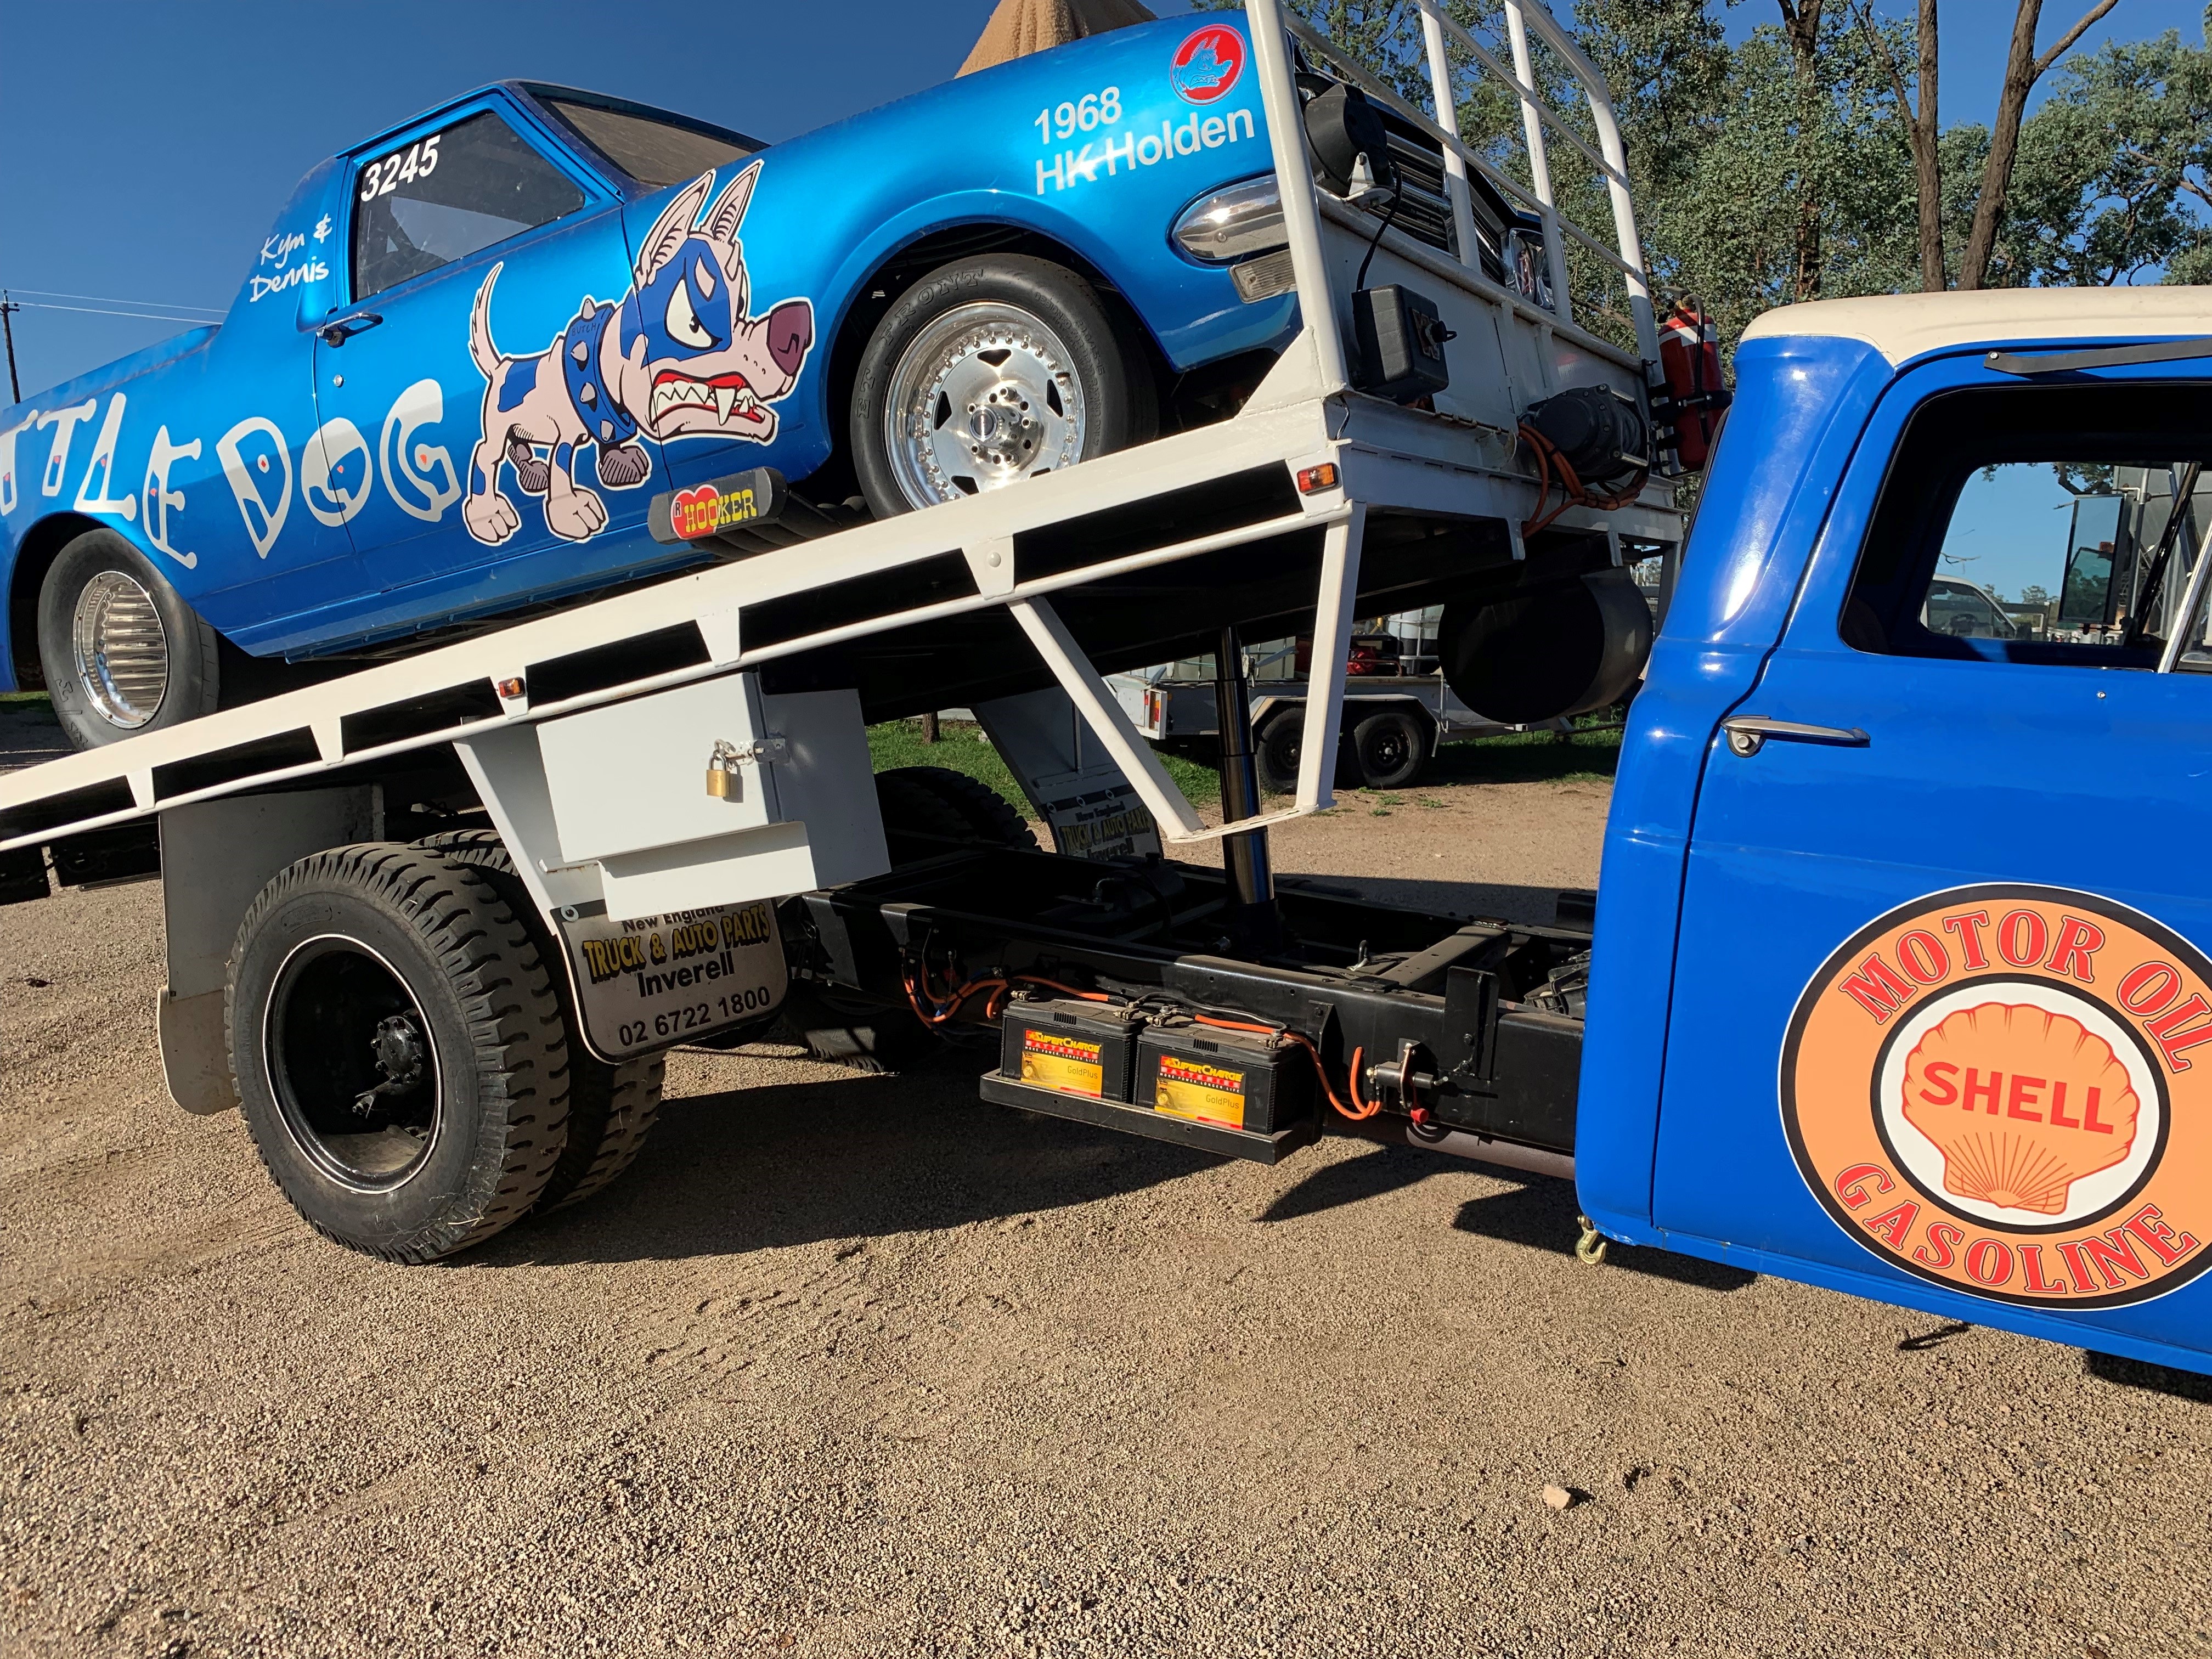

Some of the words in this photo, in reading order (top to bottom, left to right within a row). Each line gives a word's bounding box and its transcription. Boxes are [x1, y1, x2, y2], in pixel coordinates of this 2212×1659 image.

[1035, 86, 1122, 144] 1968
[361, 135, 441, 201] 3245
[1036, 143, 1098, 195] HK
[1106, 108, 1255, 176] Holden
[261, 233, 304, 269] Kym
[313, 213, 332, 243] &
[250, 256, 329, 302] Dennis
[879, 269, 984, 346] FRONT
[572, 323, 596, 336] BUTCH
[216, 378, 462, 559] DOG
[684, 489, 757, 533] HOOKER
[1059, 824, 1092, 855] TRUCK
[1101, 815, 1125, 842] AUTO
[583, 934, 647, 983] TRUCK
[650, 933, 667, 965] &
[673, 920, 719, 960] AUTO
[720, 903, 771, 949] PARTS
[622, 917, 658, 933] New
[637, 951, 735, 997] Inverell
[1839, 909, 2105, 1025] MOTOR
[2117, 961, 2212, 1074] OIL
[619, 1021, 648, 1047] 02
[655, 1003, 712, 1036] 6722
[718, 986, 770, 1017] 1800
[1068, 1066, 1098, 1079] GoldPlus
[1206, 1094, 1240, 1109] GoldPlus
[1920, 1062, 2114, 1134] SHELL
[1835, 1163, 2201, 1294] GASOLINE
